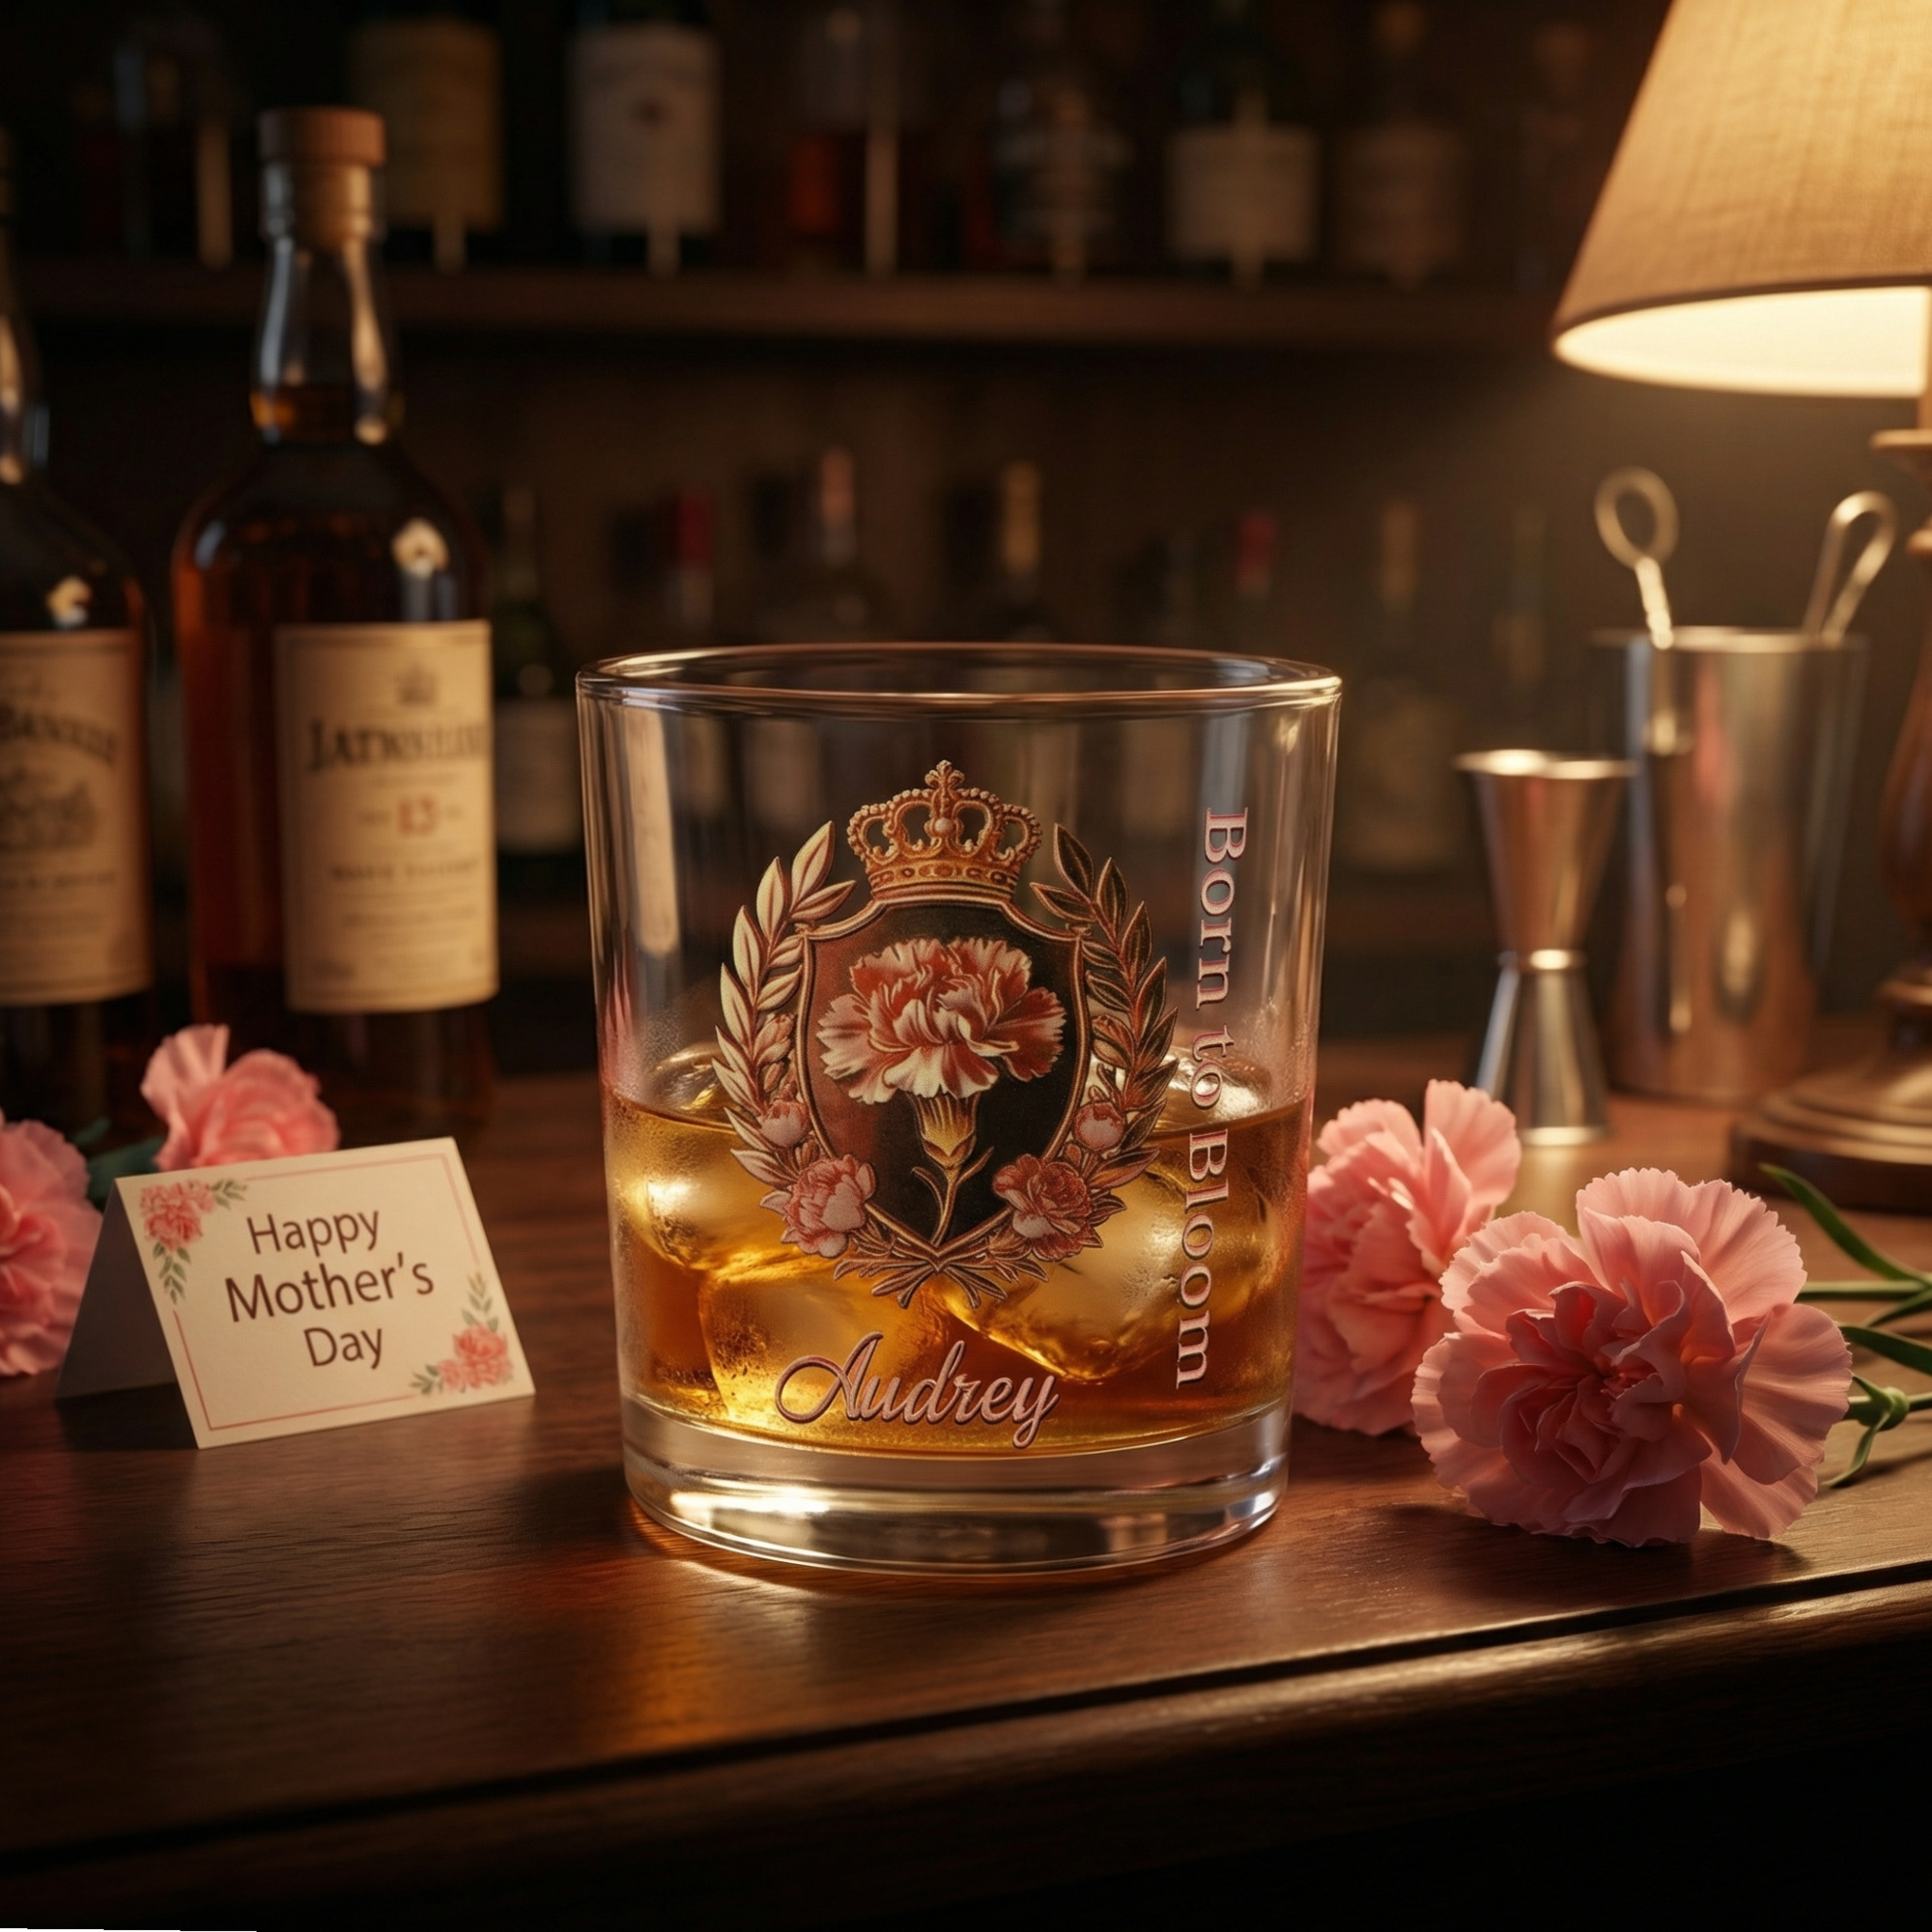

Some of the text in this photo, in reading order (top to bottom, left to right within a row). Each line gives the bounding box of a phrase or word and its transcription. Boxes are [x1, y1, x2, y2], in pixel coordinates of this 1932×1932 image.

[1176, 807, 1248, 1389] Born to Bloom
[246, 1210, 379, 1258] Happy
[225, 1251, 434, 1322] Mother's
[303, 1328, 383, 1370] Day
[775, 1331, 1060, 1449] Audrey
